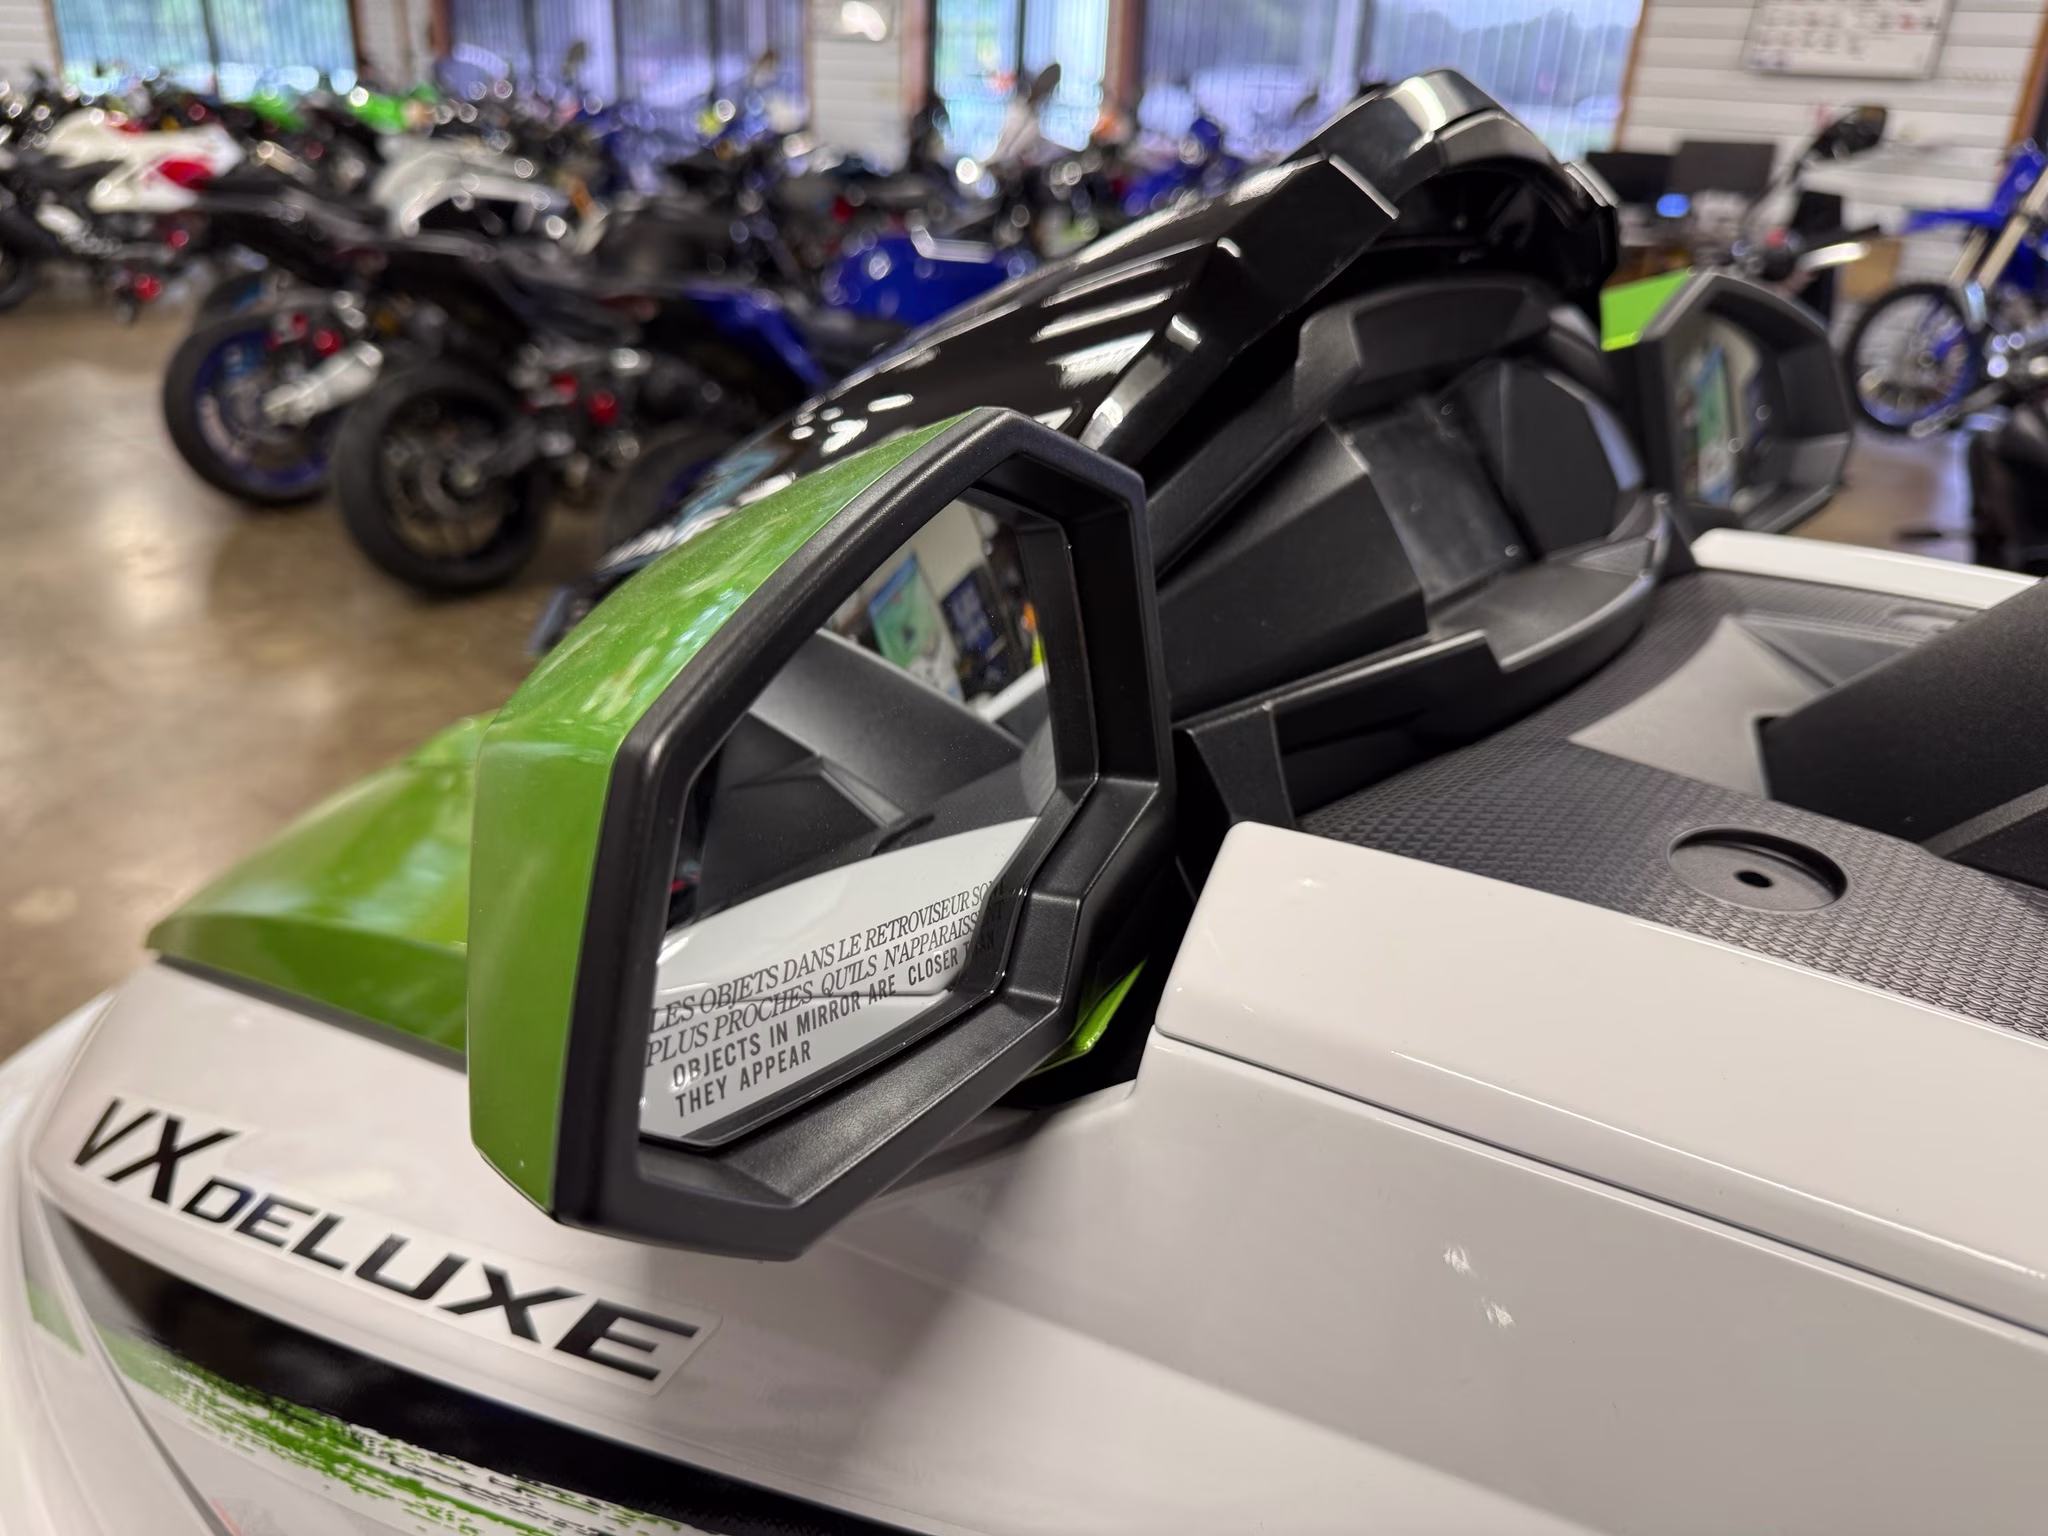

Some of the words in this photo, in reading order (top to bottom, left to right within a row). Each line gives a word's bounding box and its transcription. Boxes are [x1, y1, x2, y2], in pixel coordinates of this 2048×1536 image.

[645, 1022, 709, 1068] PLUS
[712, 980, 814, 1042] PROCHES
[650, 996, 695, 1034] LES
[700, 965, 779, 1014] OBJETS
[782, 943, 835, 984] DANS
[838, 933, 862, 962] LE
[864, 891, 970, 951] RETROVISEUR
[673, 1032, 761, 1088] OBJECTS
[769, 1020, 788, 1048] IN
[796, 990, 861, 1037] MIRROR
[868, 974, 896, 1005] ARE
[908, 946, 958, 986] CLOSER
[675, 1075, 727, 1117] THEY
[739, 1040, 811, 1091] APPEAR
[74, 1098, 240, 1204] VX
[180, 1175, 700, 1382] DELUXE
